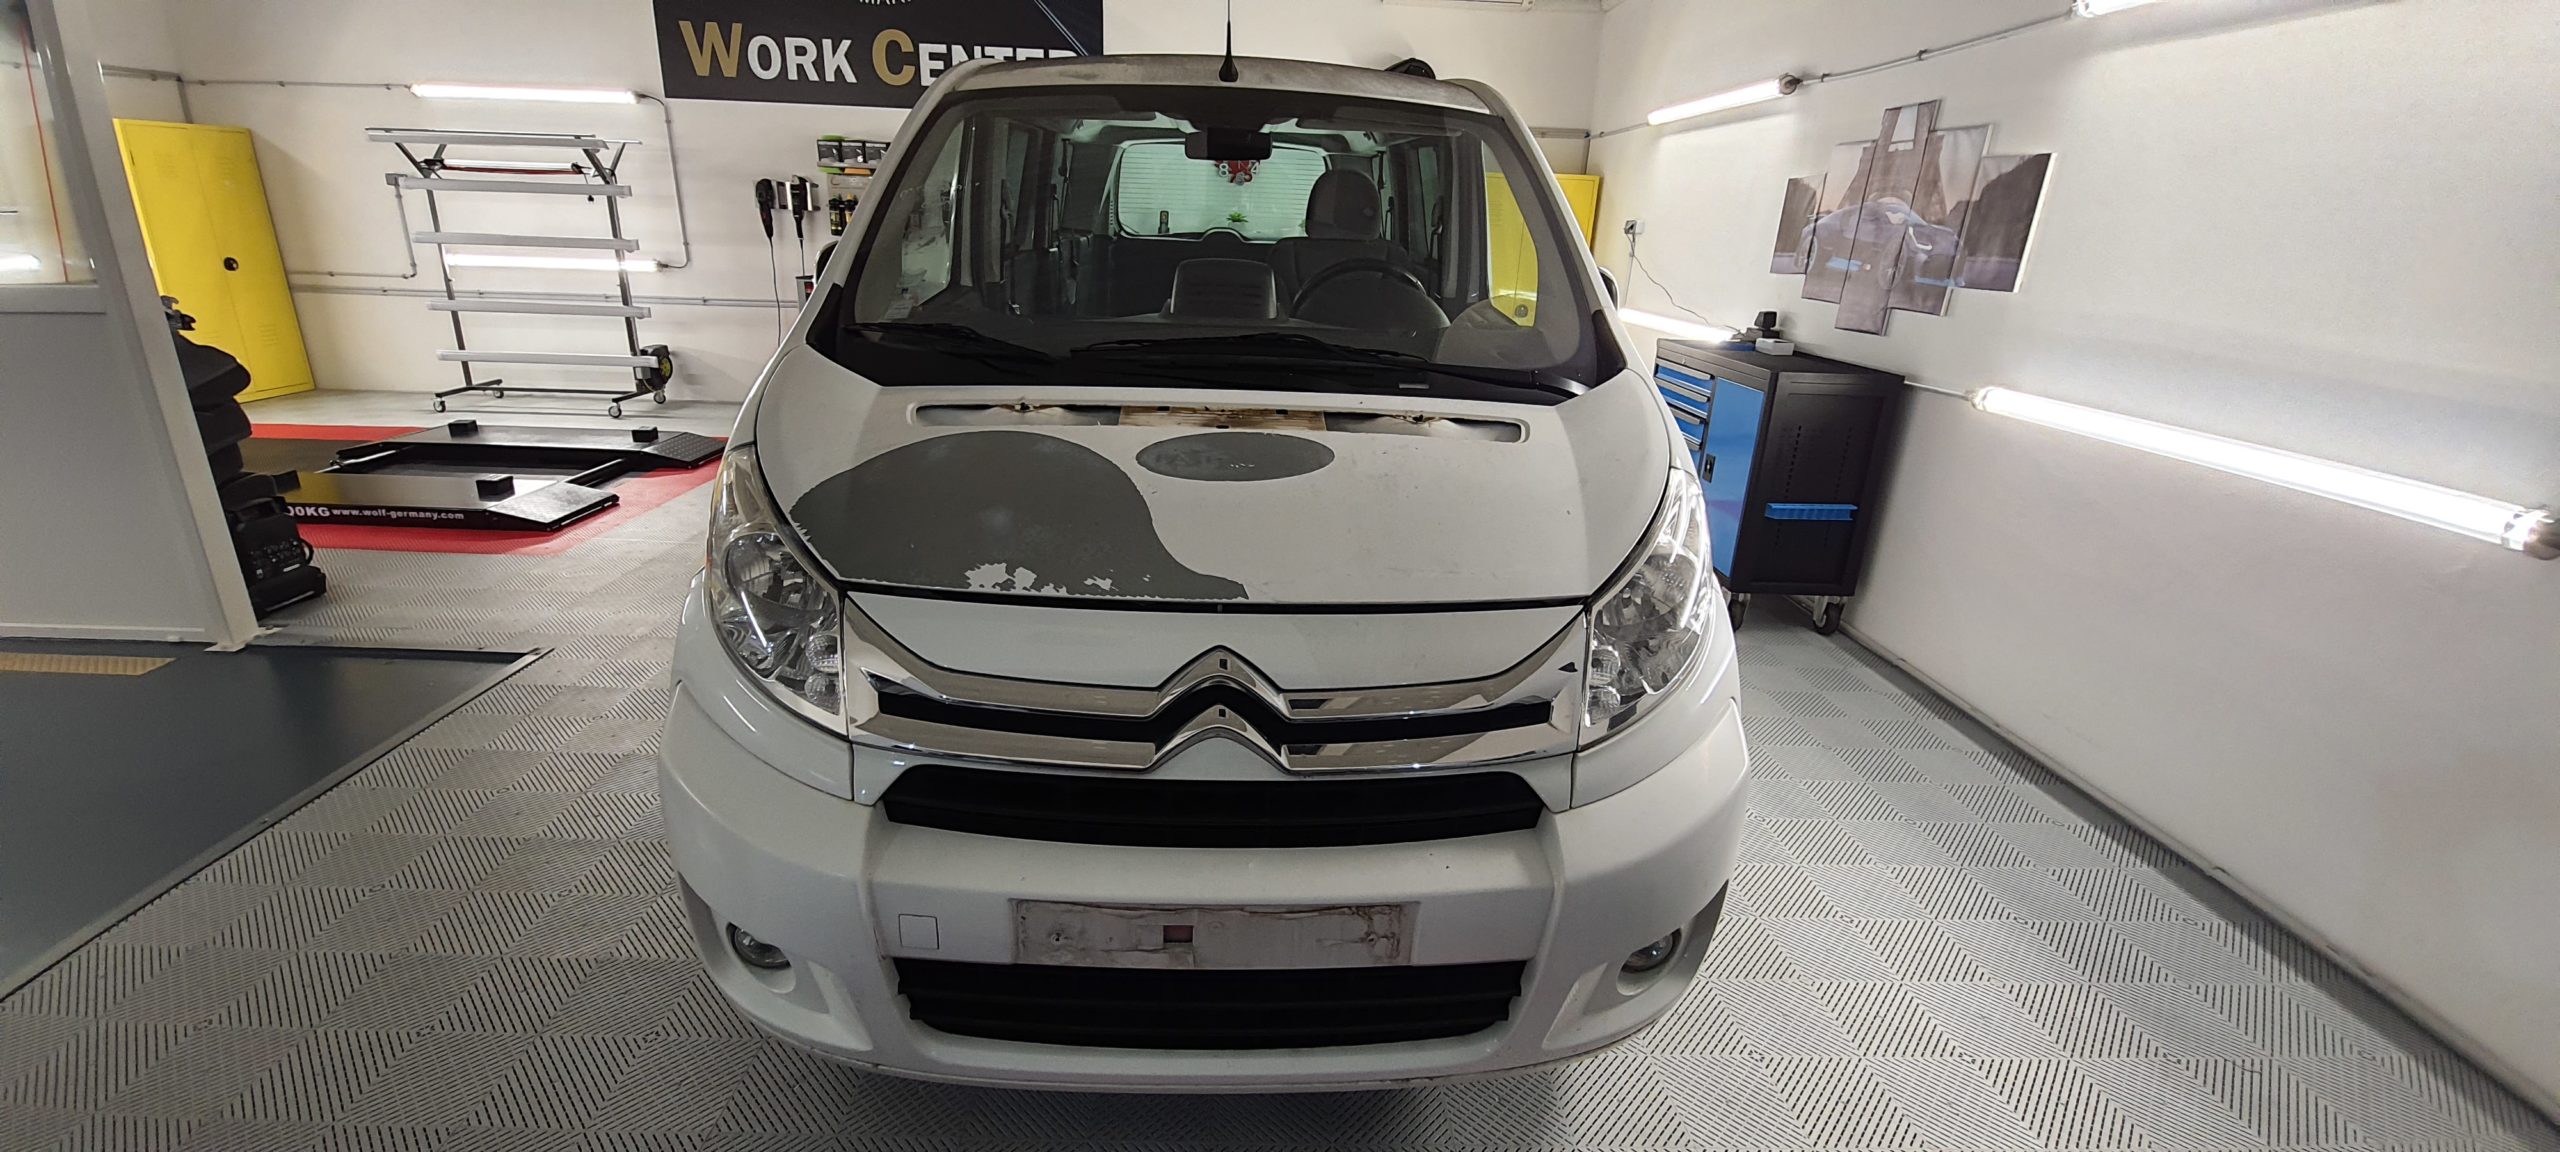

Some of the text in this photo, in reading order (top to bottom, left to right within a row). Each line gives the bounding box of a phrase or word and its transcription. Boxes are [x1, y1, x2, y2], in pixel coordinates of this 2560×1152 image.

[678, 20, 1077, 87] WORK CEN
[332, 508, 465, 520] www.wolf-germany.com
